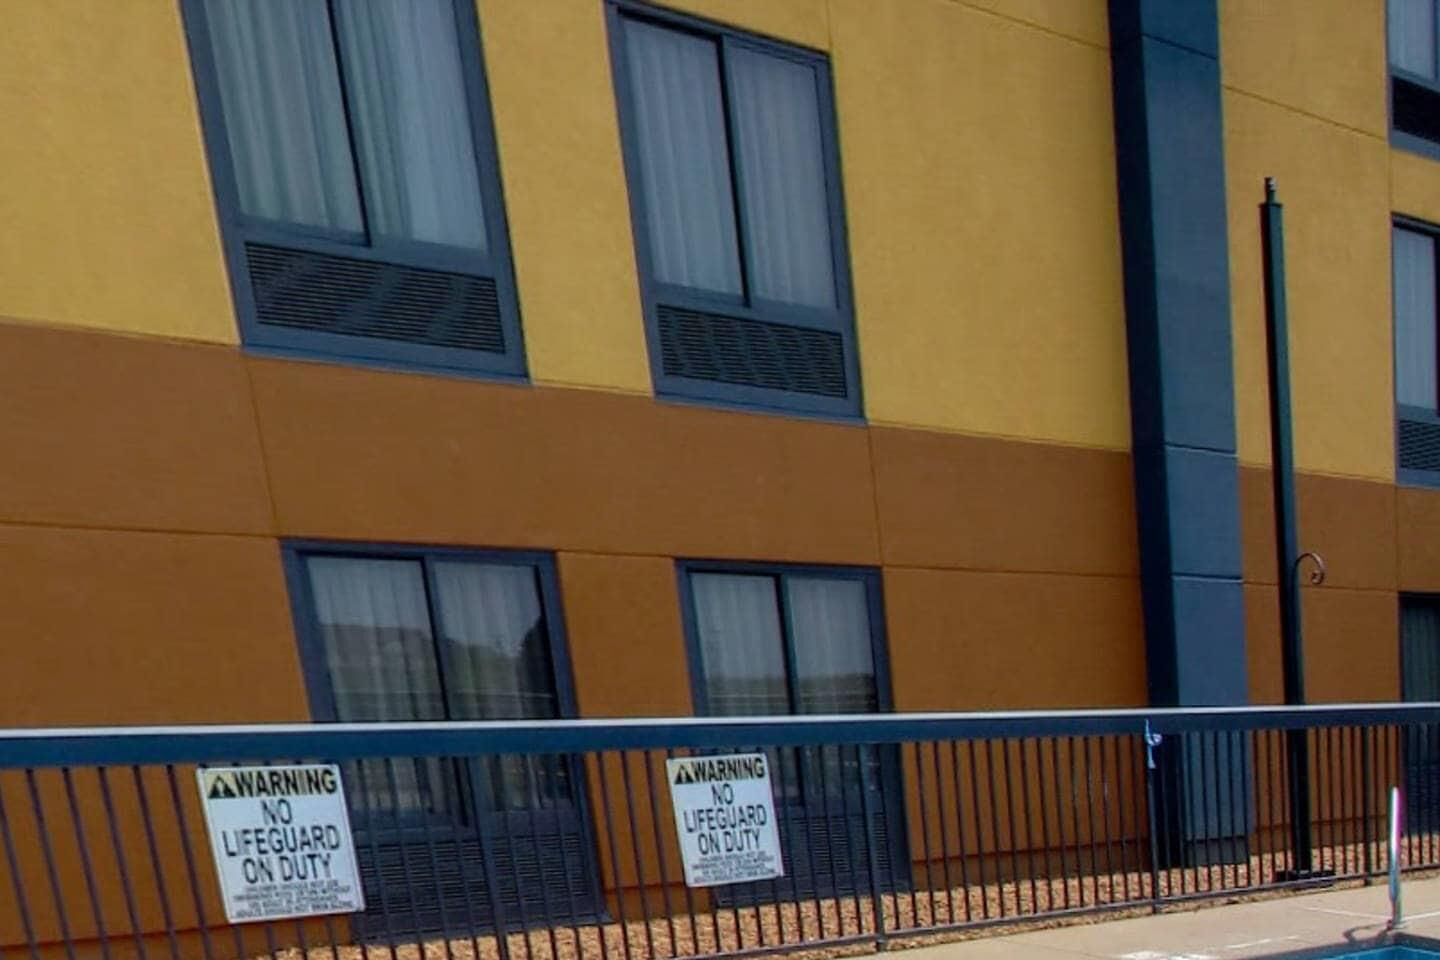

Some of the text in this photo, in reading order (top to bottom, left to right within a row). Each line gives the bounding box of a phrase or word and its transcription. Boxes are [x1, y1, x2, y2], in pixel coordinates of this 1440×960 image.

[233, 768, 337, 798] WARNING
[691, 757, 766, 782] WARNING
[711, 783, 734, 806] NO
[262, 798, 293, 825] NO
[683, 805, 768, 833] LIFEGUARD
[222, 825, 341, 857] LIFEGUARD
[698, 829, 761, 855] ON DUTY
[243, 853, 333, 884] ON DUTY
